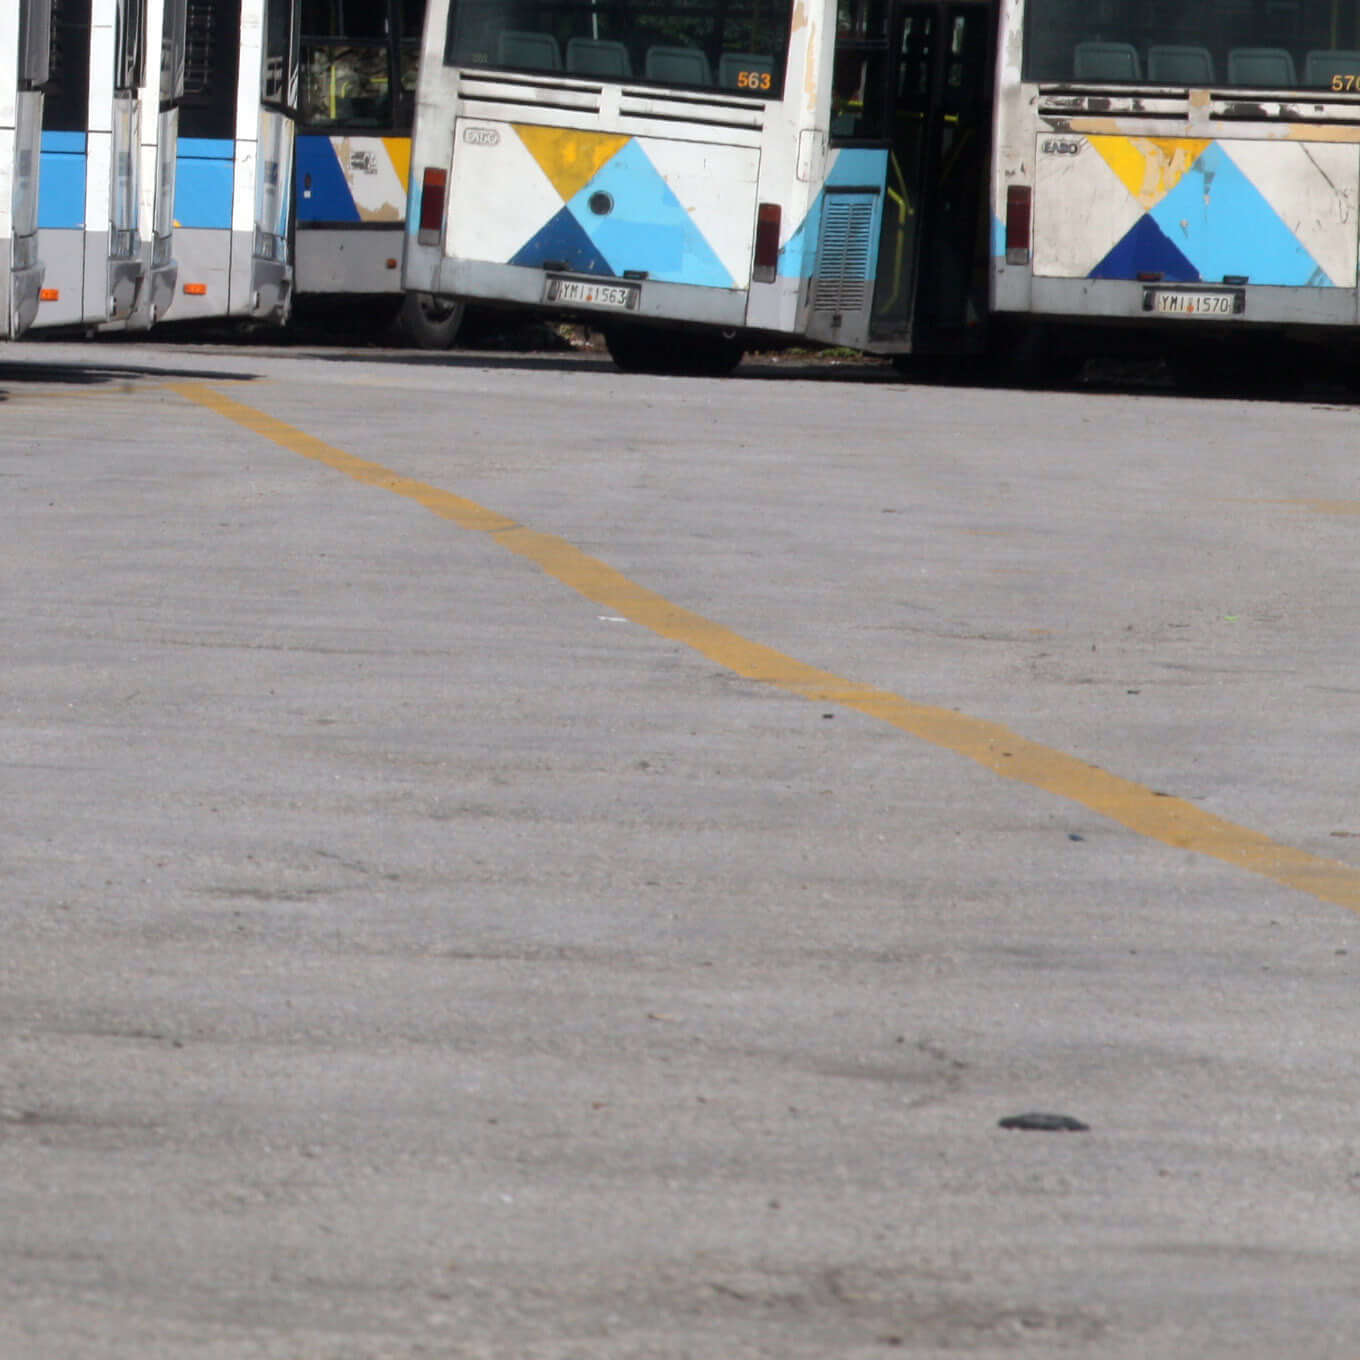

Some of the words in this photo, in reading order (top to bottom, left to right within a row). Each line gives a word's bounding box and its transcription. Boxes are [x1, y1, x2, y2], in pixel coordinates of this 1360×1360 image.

[737, 71, 771, 89] 563
[594, 287, 626, 305] 1563
[1196, 296, 1229, 313] 1570
